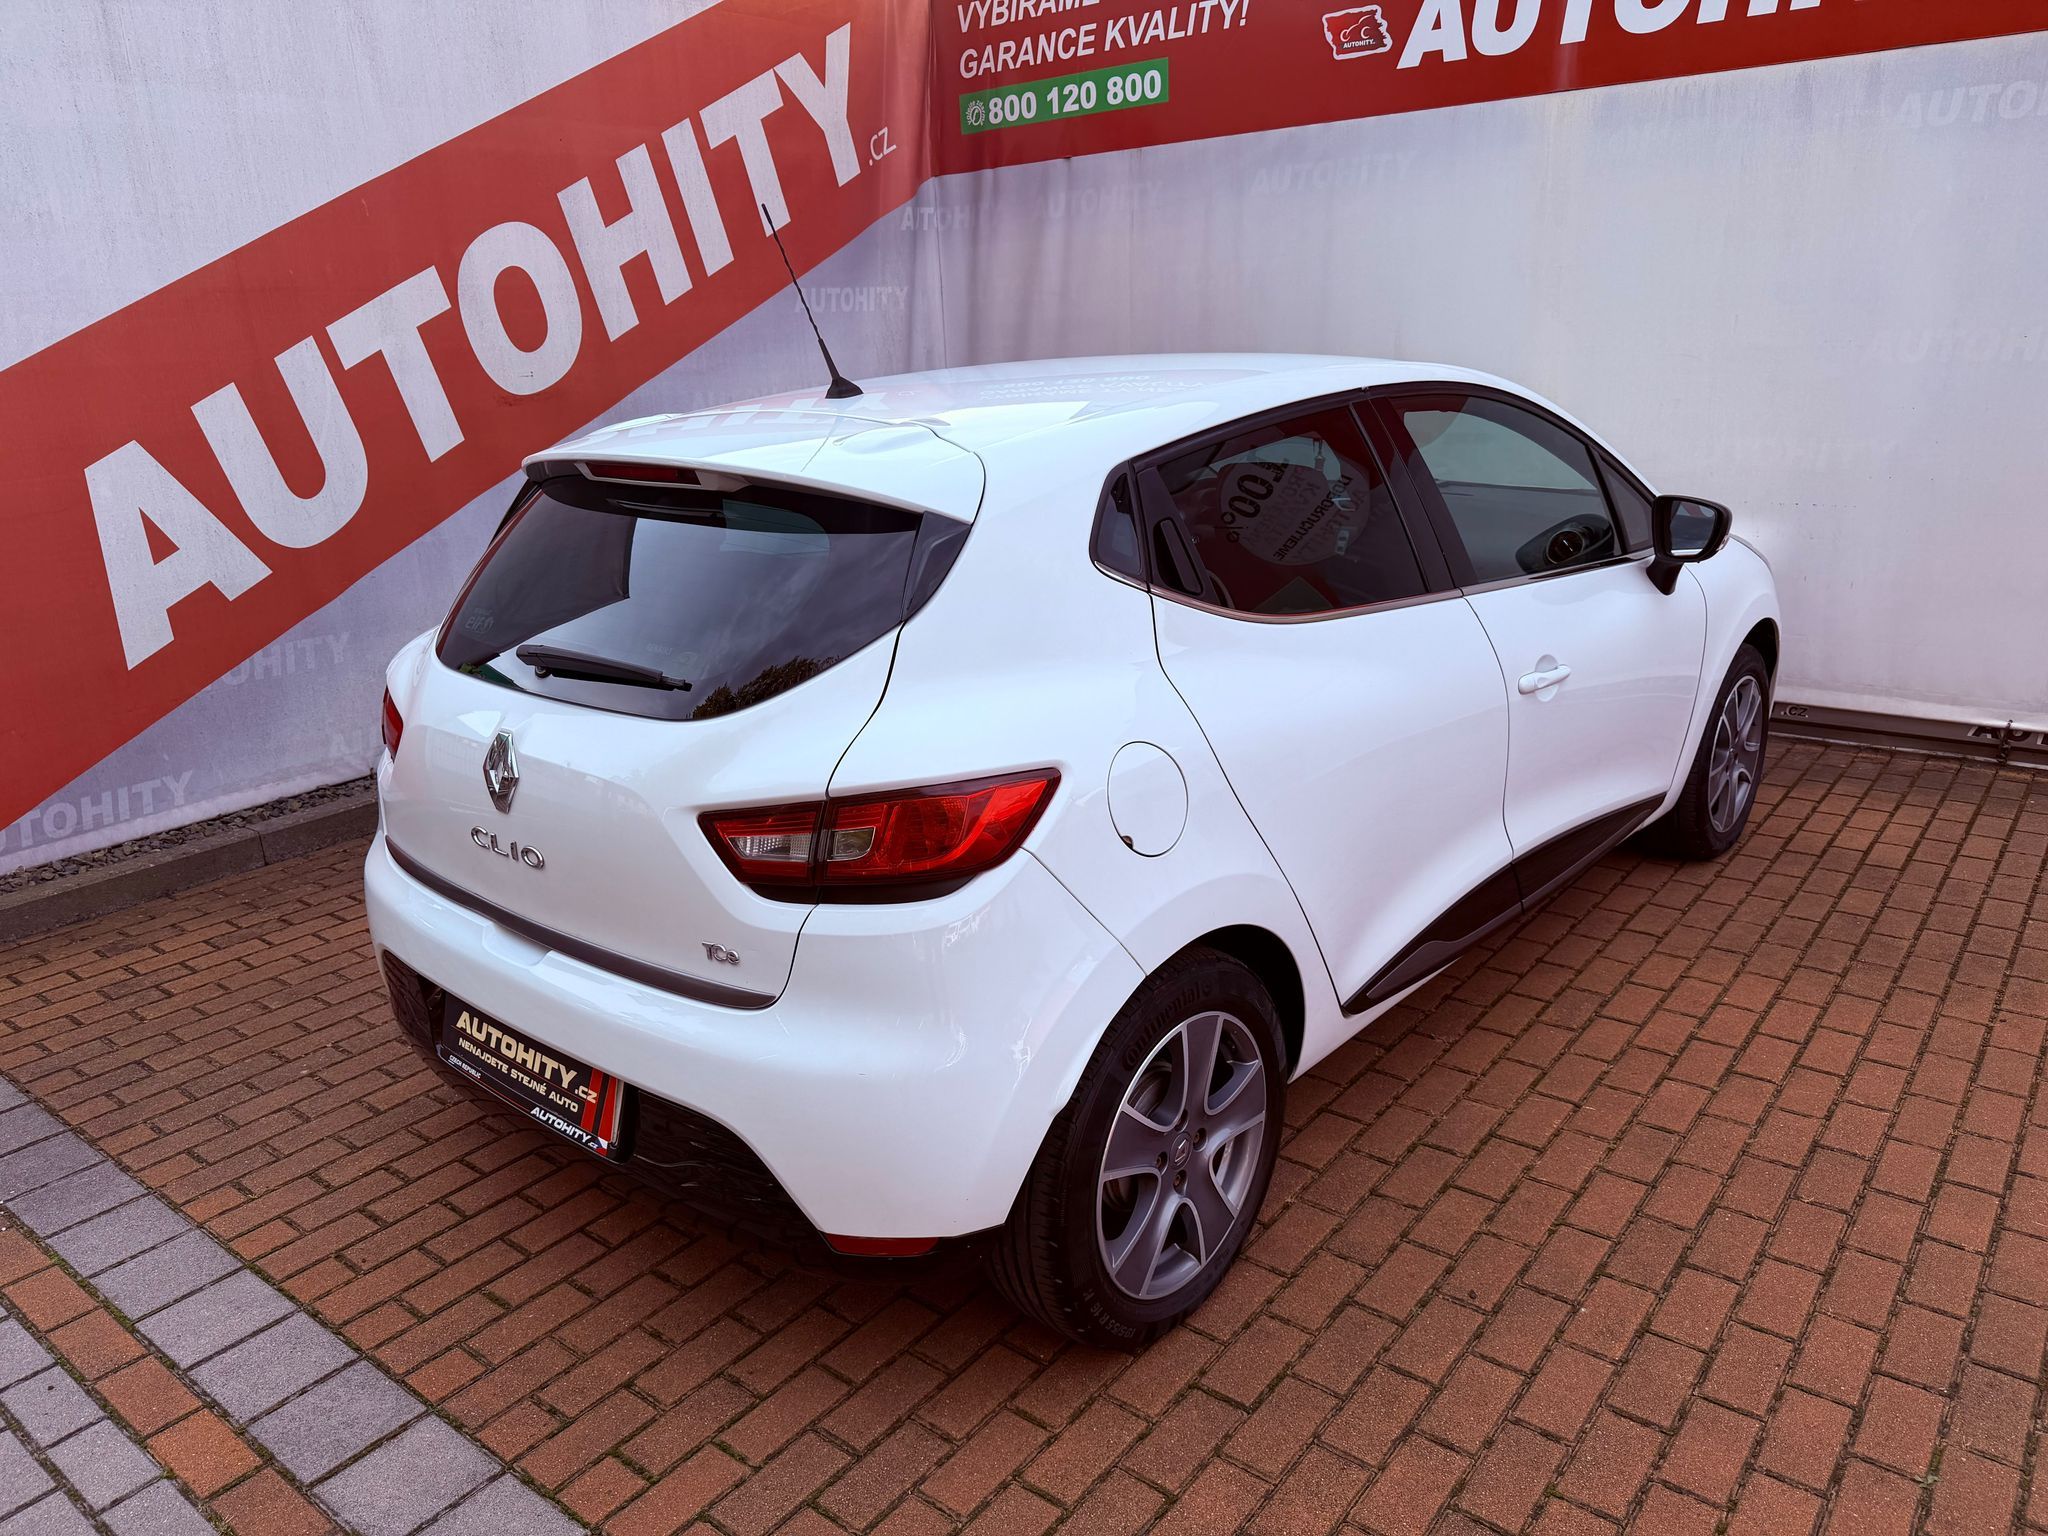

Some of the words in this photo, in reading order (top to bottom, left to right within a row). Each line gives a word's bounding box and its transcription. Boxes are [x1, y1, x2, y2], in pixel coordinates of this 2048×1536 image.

[959, 23, 1097, 79] GARANCE
[1104, 0, 1249, 51] KVALITY!
[988, 91, 1037, 125] 800
[1047, 81, 1097, 115] 120
[1107, 69, 1162, 105] 800
[84, 22, 862, 671] AUTOHITY
[471, 826, 545, 869] CLIO
[456, 1010, 577, 1089] AUTOHITY
[458, 1037, 509, 1074] NENAJDETE
[510, 1067, 548, 1096] STEJNÉ
[548, 1090, 580, 1113] AUTO
[530, 1106, 590, 1144] AUTOHITY
